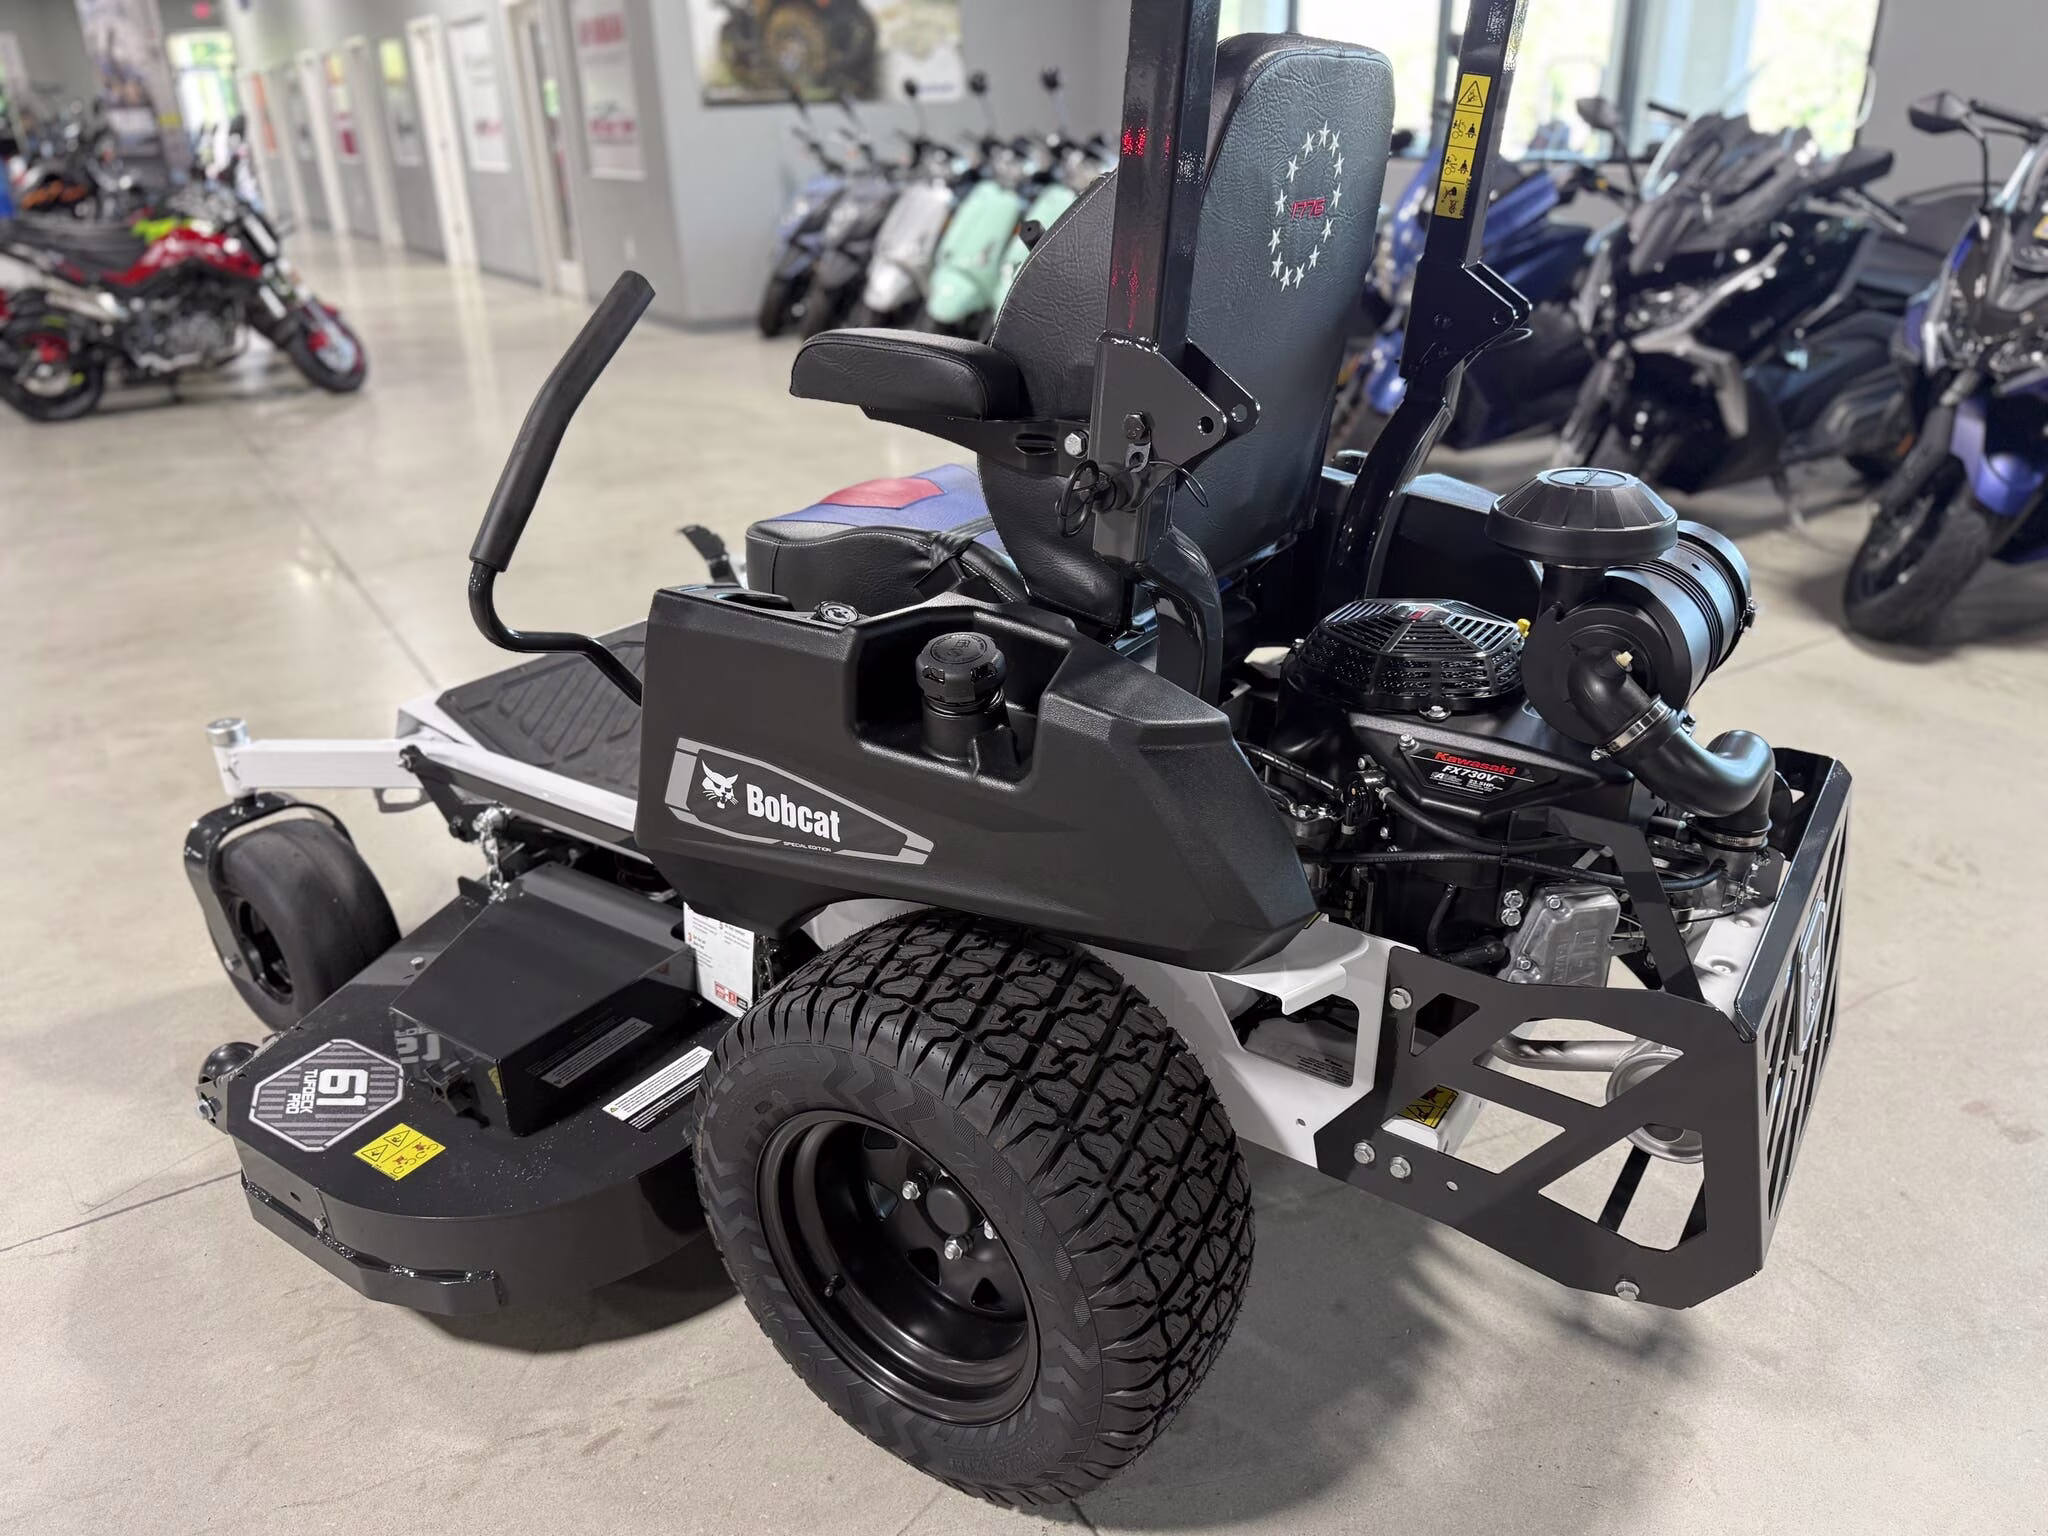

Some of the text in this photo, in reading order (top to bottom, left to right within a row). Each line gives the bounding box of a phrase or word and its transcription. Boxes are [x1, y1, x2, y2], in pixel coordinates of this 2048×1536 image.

[1291, 197, 1327, 220] 1776
[1434, 751, 1517, 775] Kawasaki
[1442, 765, 1497, 782] FX730V
[746, 783, 841, 843] Bobcat
[783, 841, 832, 853] SPECIAL EDITION
[299, 1068, 319, 1114] TUFDECK
[316, 1068, 369, 1106] 61
[285, 1093, 301, 1115] PRO
